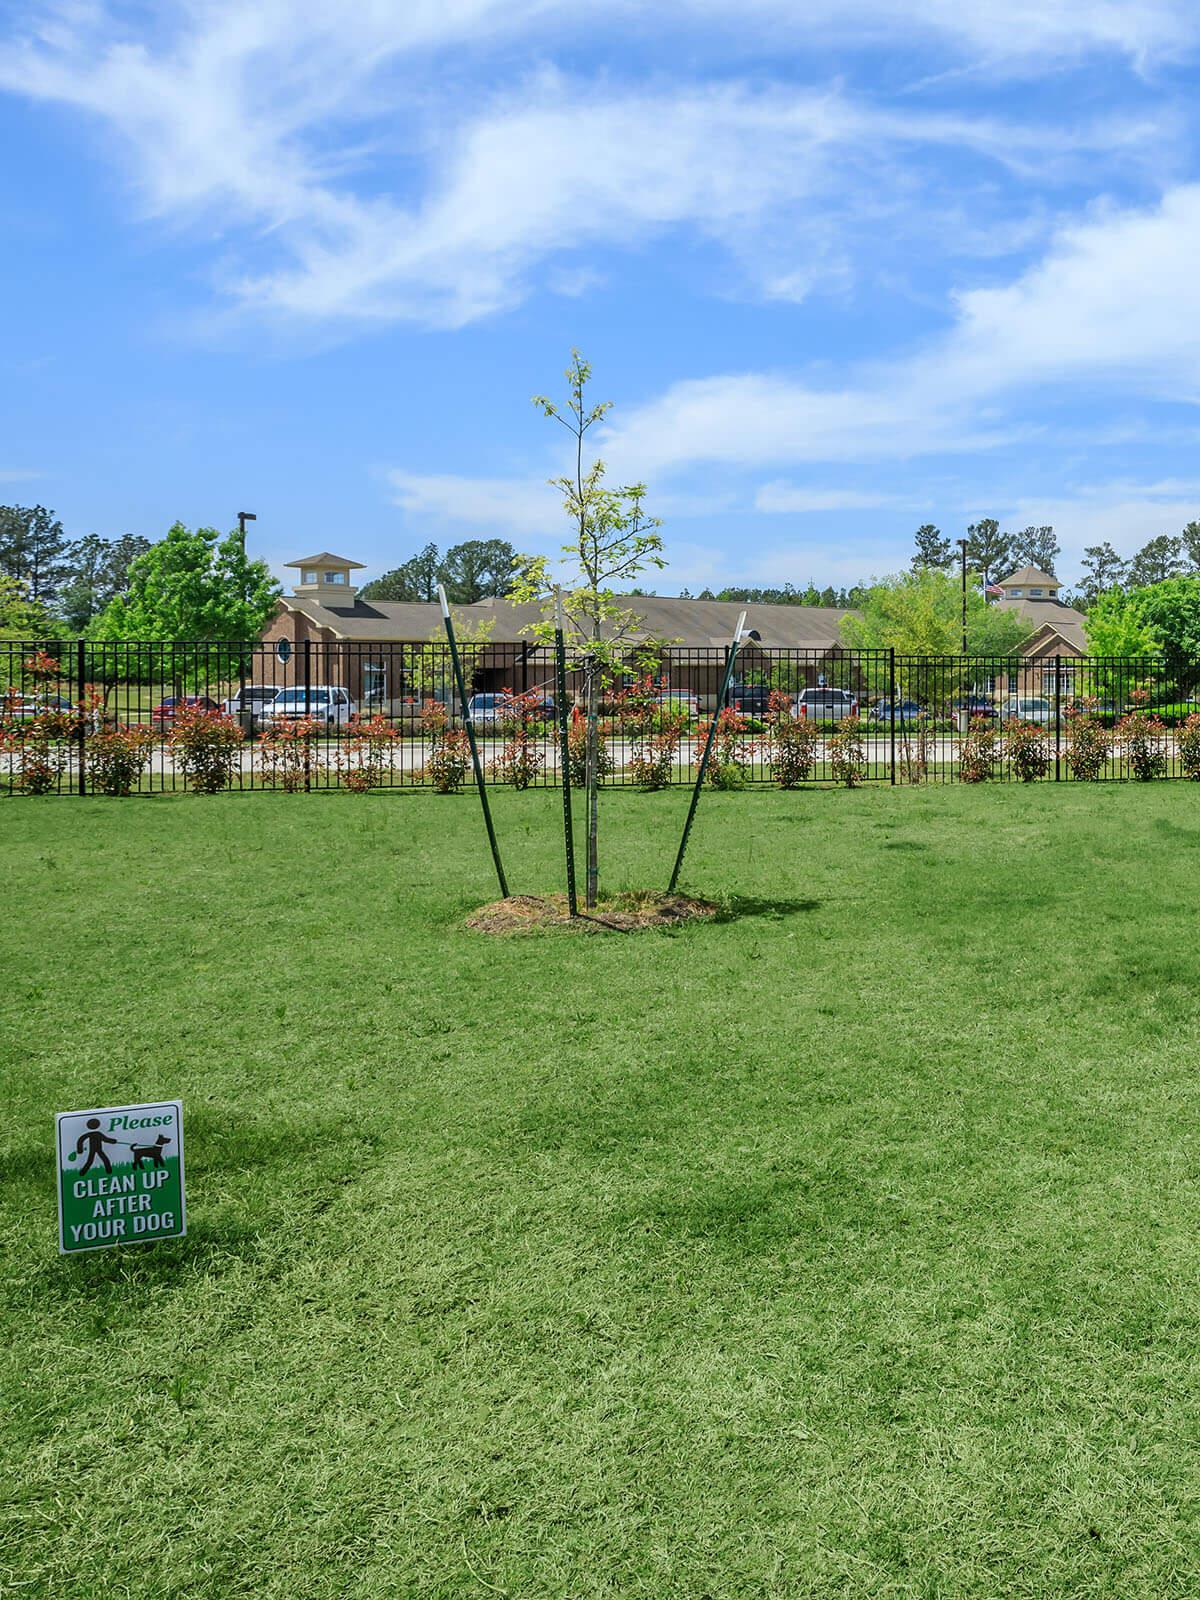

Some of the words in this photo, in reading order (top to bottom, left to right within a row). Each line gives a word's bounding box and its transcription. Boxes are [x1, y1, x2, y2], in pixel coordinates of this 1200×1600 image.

[108, 1115, 173, 1132] Please
[73, 1174, 135, 1199] CLEAN
[142, 1170, 169, 1189] UP
[92, 1193, 152, 1218] AFTER
[70, 1218, 126, 1242] YOUR
[133, 1212, 174, 1234] DOG
